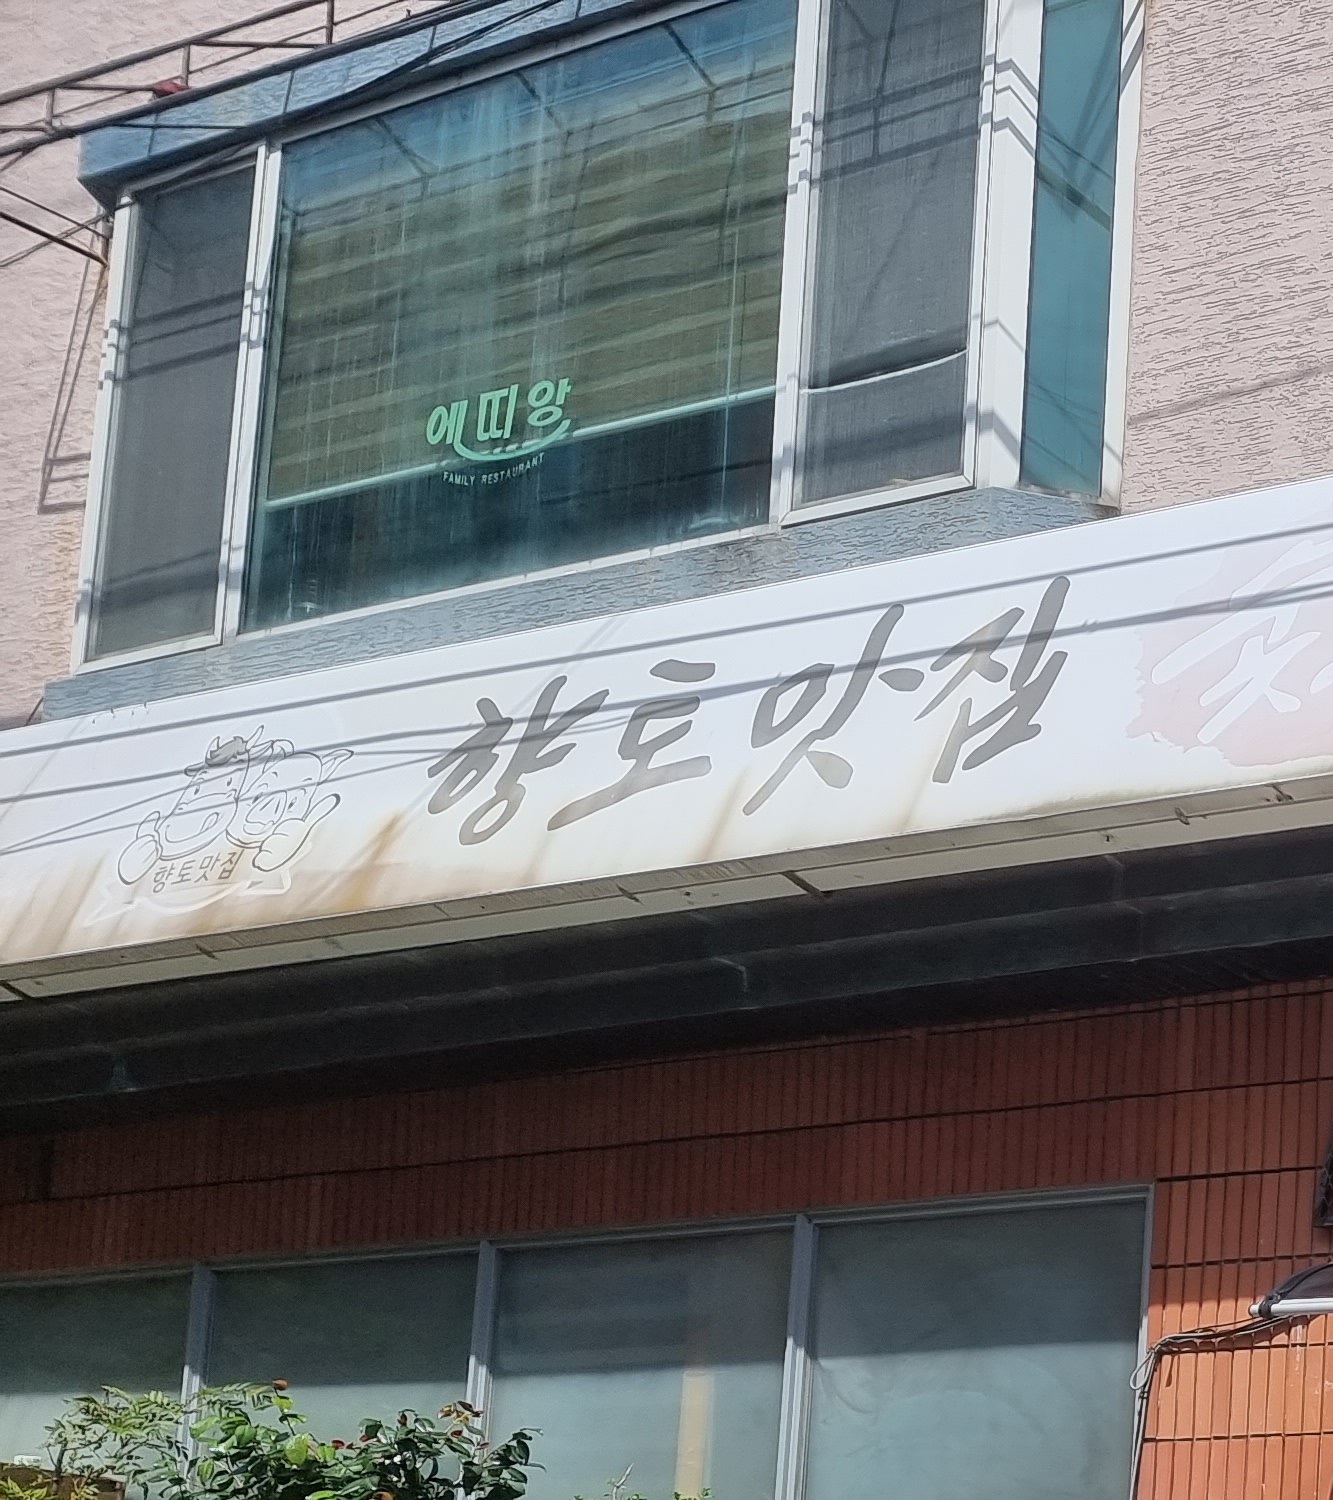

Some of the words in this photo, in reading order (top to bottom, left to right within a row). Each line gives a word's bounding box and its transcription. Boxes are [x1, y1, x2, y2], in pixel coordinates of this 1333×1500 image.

[443, 471, 475, 486] FAMILY
[481, 452, 545, 485] RESTAURANT
[428, 574, 1069, 846] 향토맛집
[153, 849, 244, 894] 향토맛집
